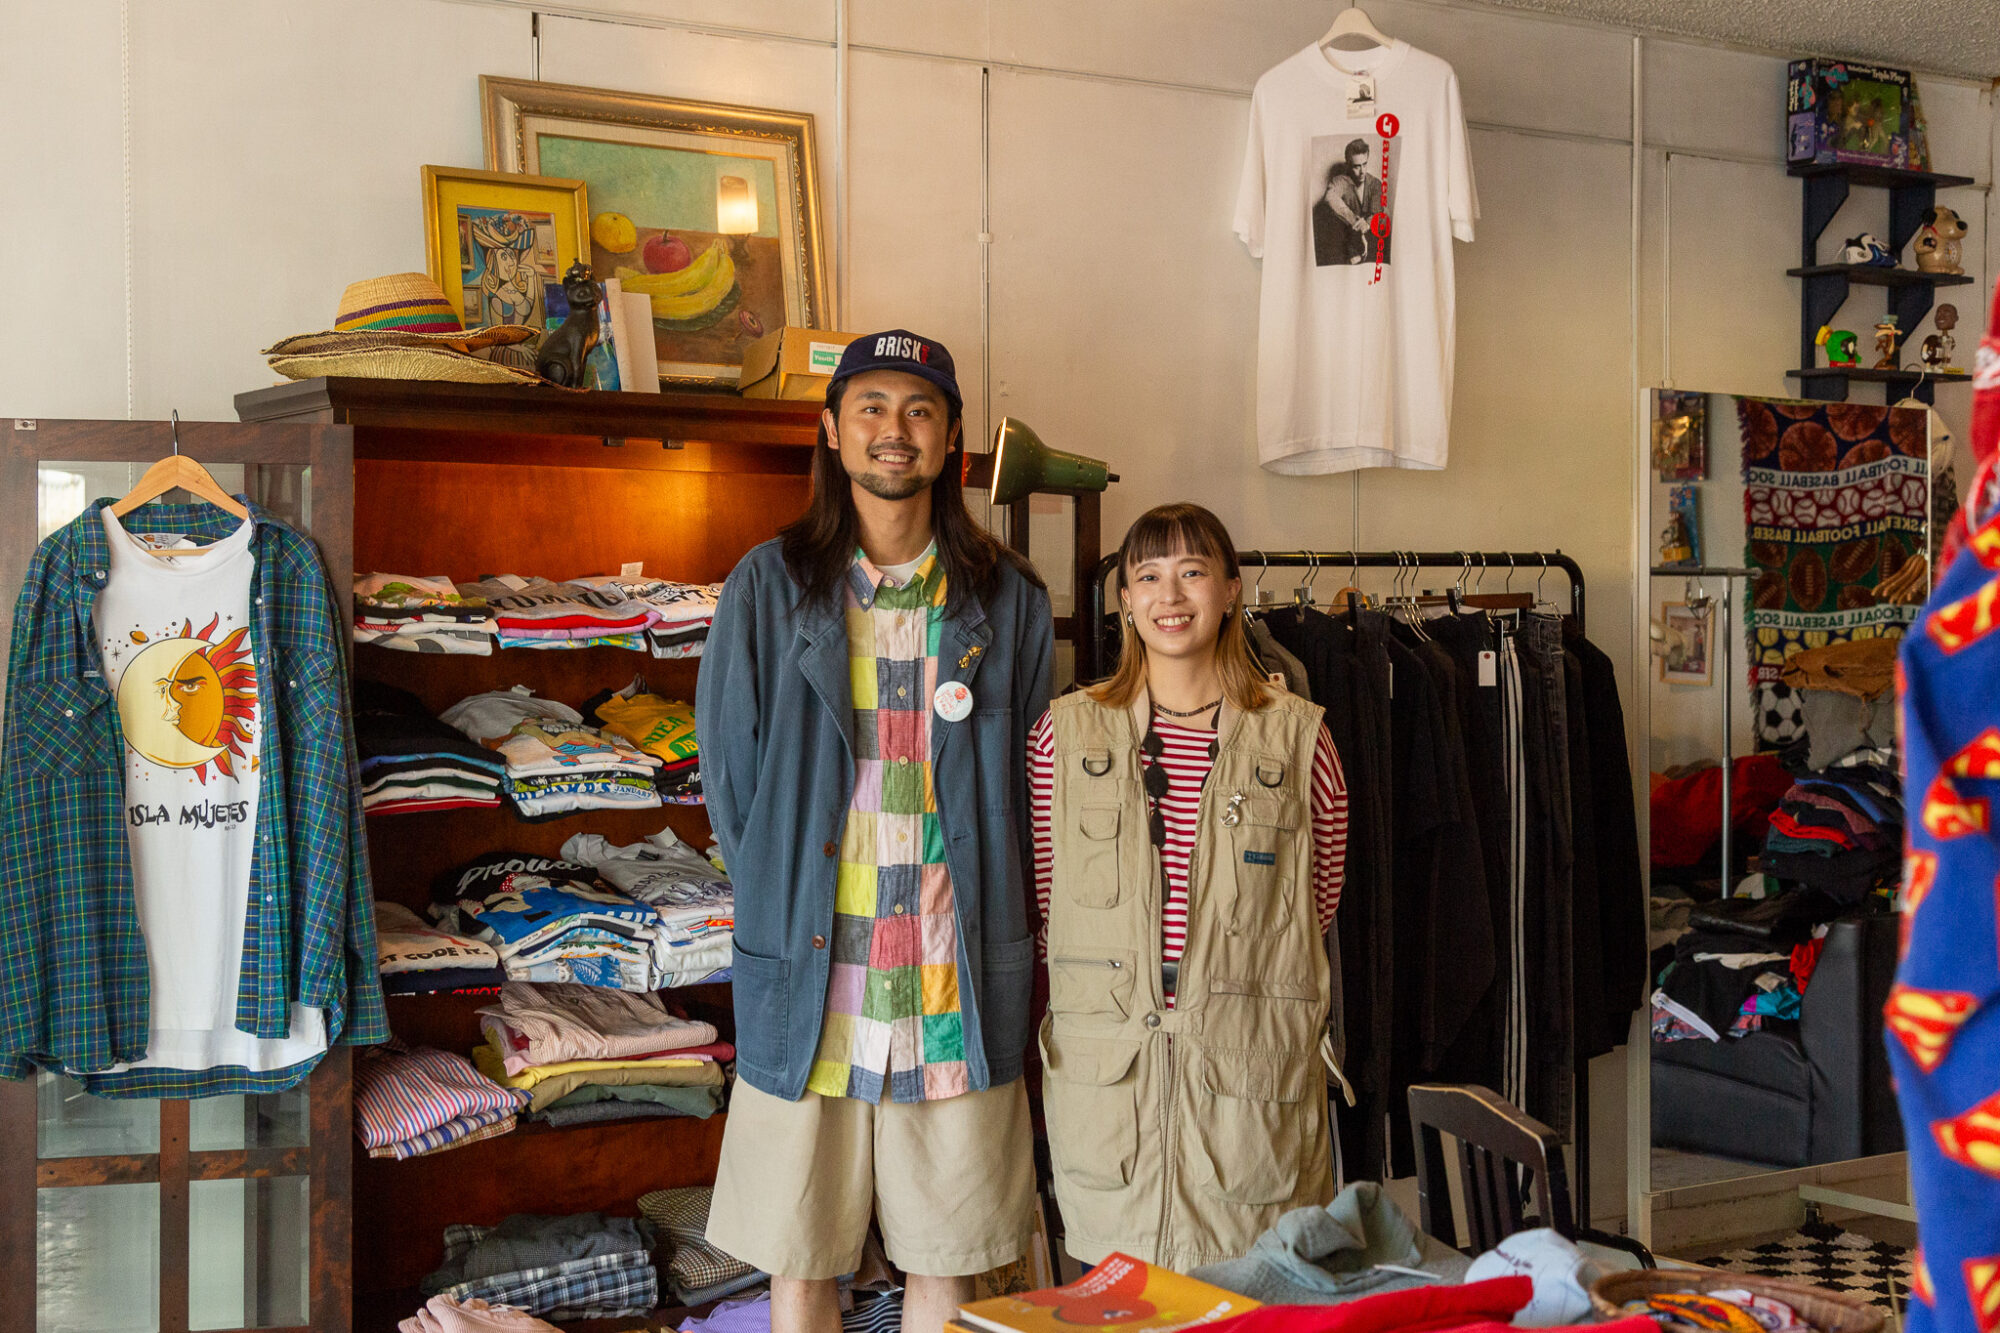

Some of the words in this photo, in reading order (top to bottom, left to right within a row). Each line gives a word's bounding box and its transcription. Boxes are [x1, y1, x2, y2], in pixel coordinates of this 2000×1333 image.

[1376, 113, 1400, 208] James
[1370, 212, 1391, 284] Dean
[614, 784, 652, 797] JANUARY
[129, 803, 170, 827] ISLA
[404, 946, 459, 961] CODE
